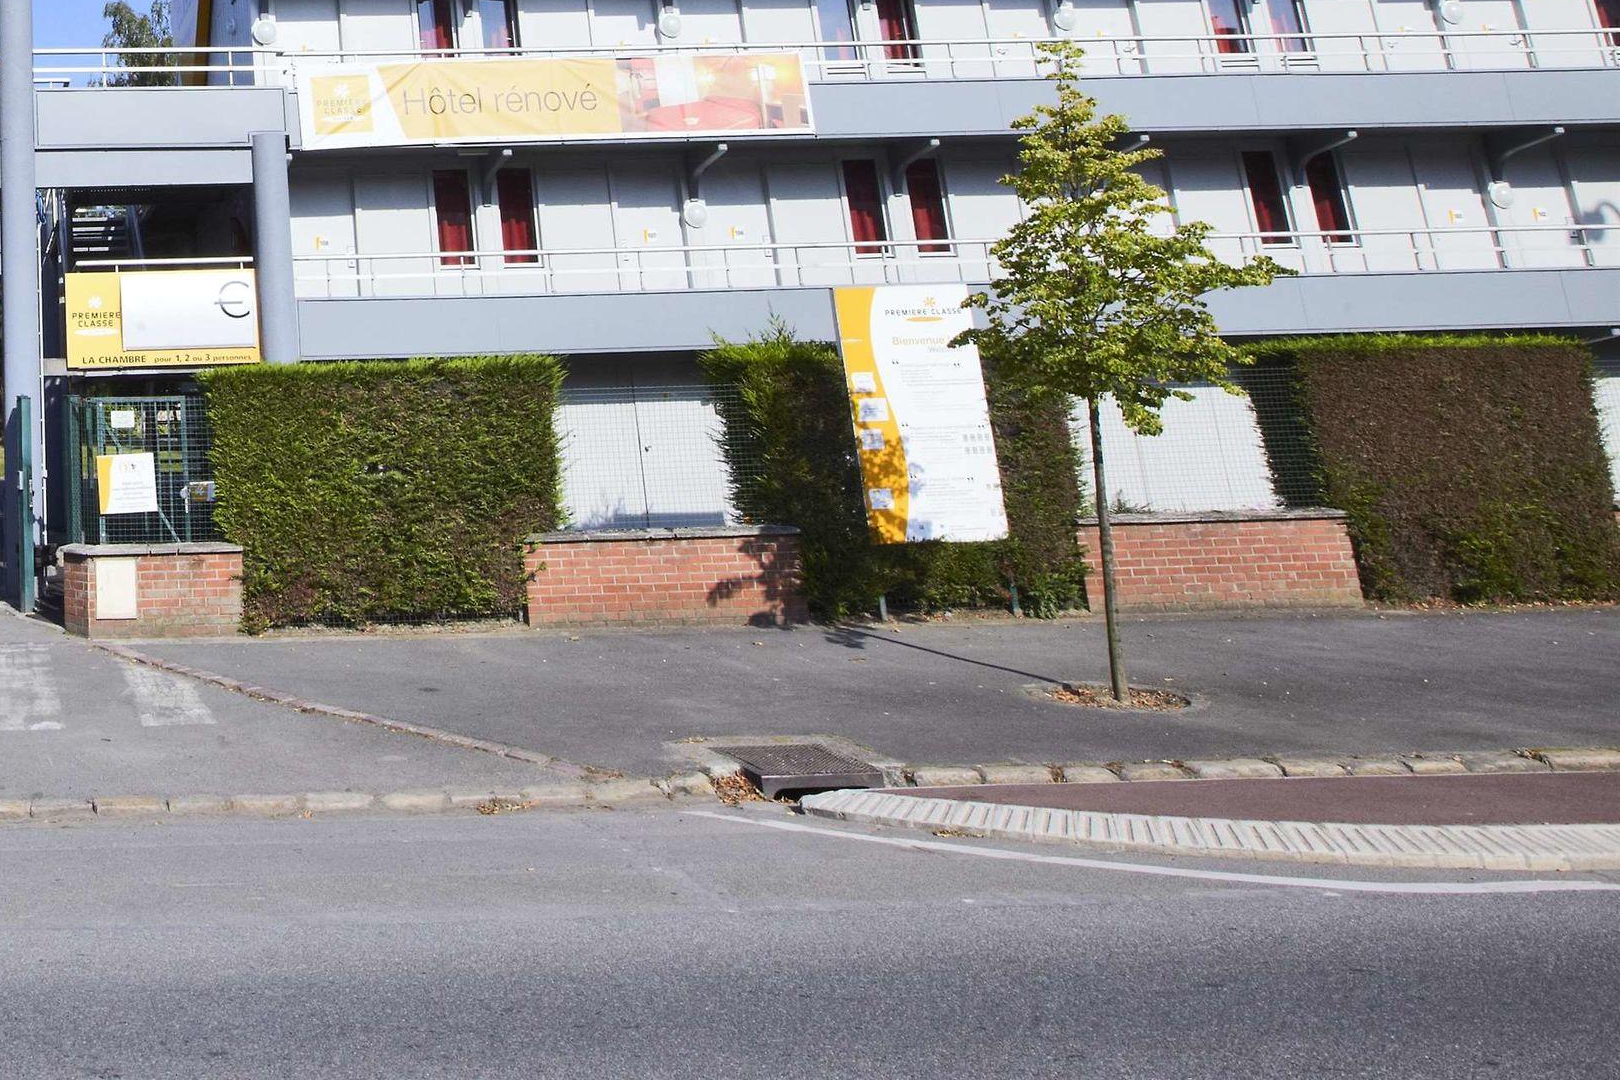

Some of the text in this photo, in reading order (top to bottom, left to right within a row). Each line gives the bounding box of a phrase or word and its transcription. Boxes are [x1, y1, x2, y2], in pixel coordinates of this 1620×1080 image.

[403, 83, 597, 115] Hôtel rénové
[213, 280, 251, 319] €
[72, 311, 122, 320] PREMIERE
[884, 307, 962, 317] PREMIERE CLASSE
[78, 320, 114, 328] CLASSE
[891, 336, 945, 346] Bienvenue
[82, 356, 95, 364] LA
[98, 355, 147, 364] CHAMBRE
[212, 355, 252, 363] personnes
